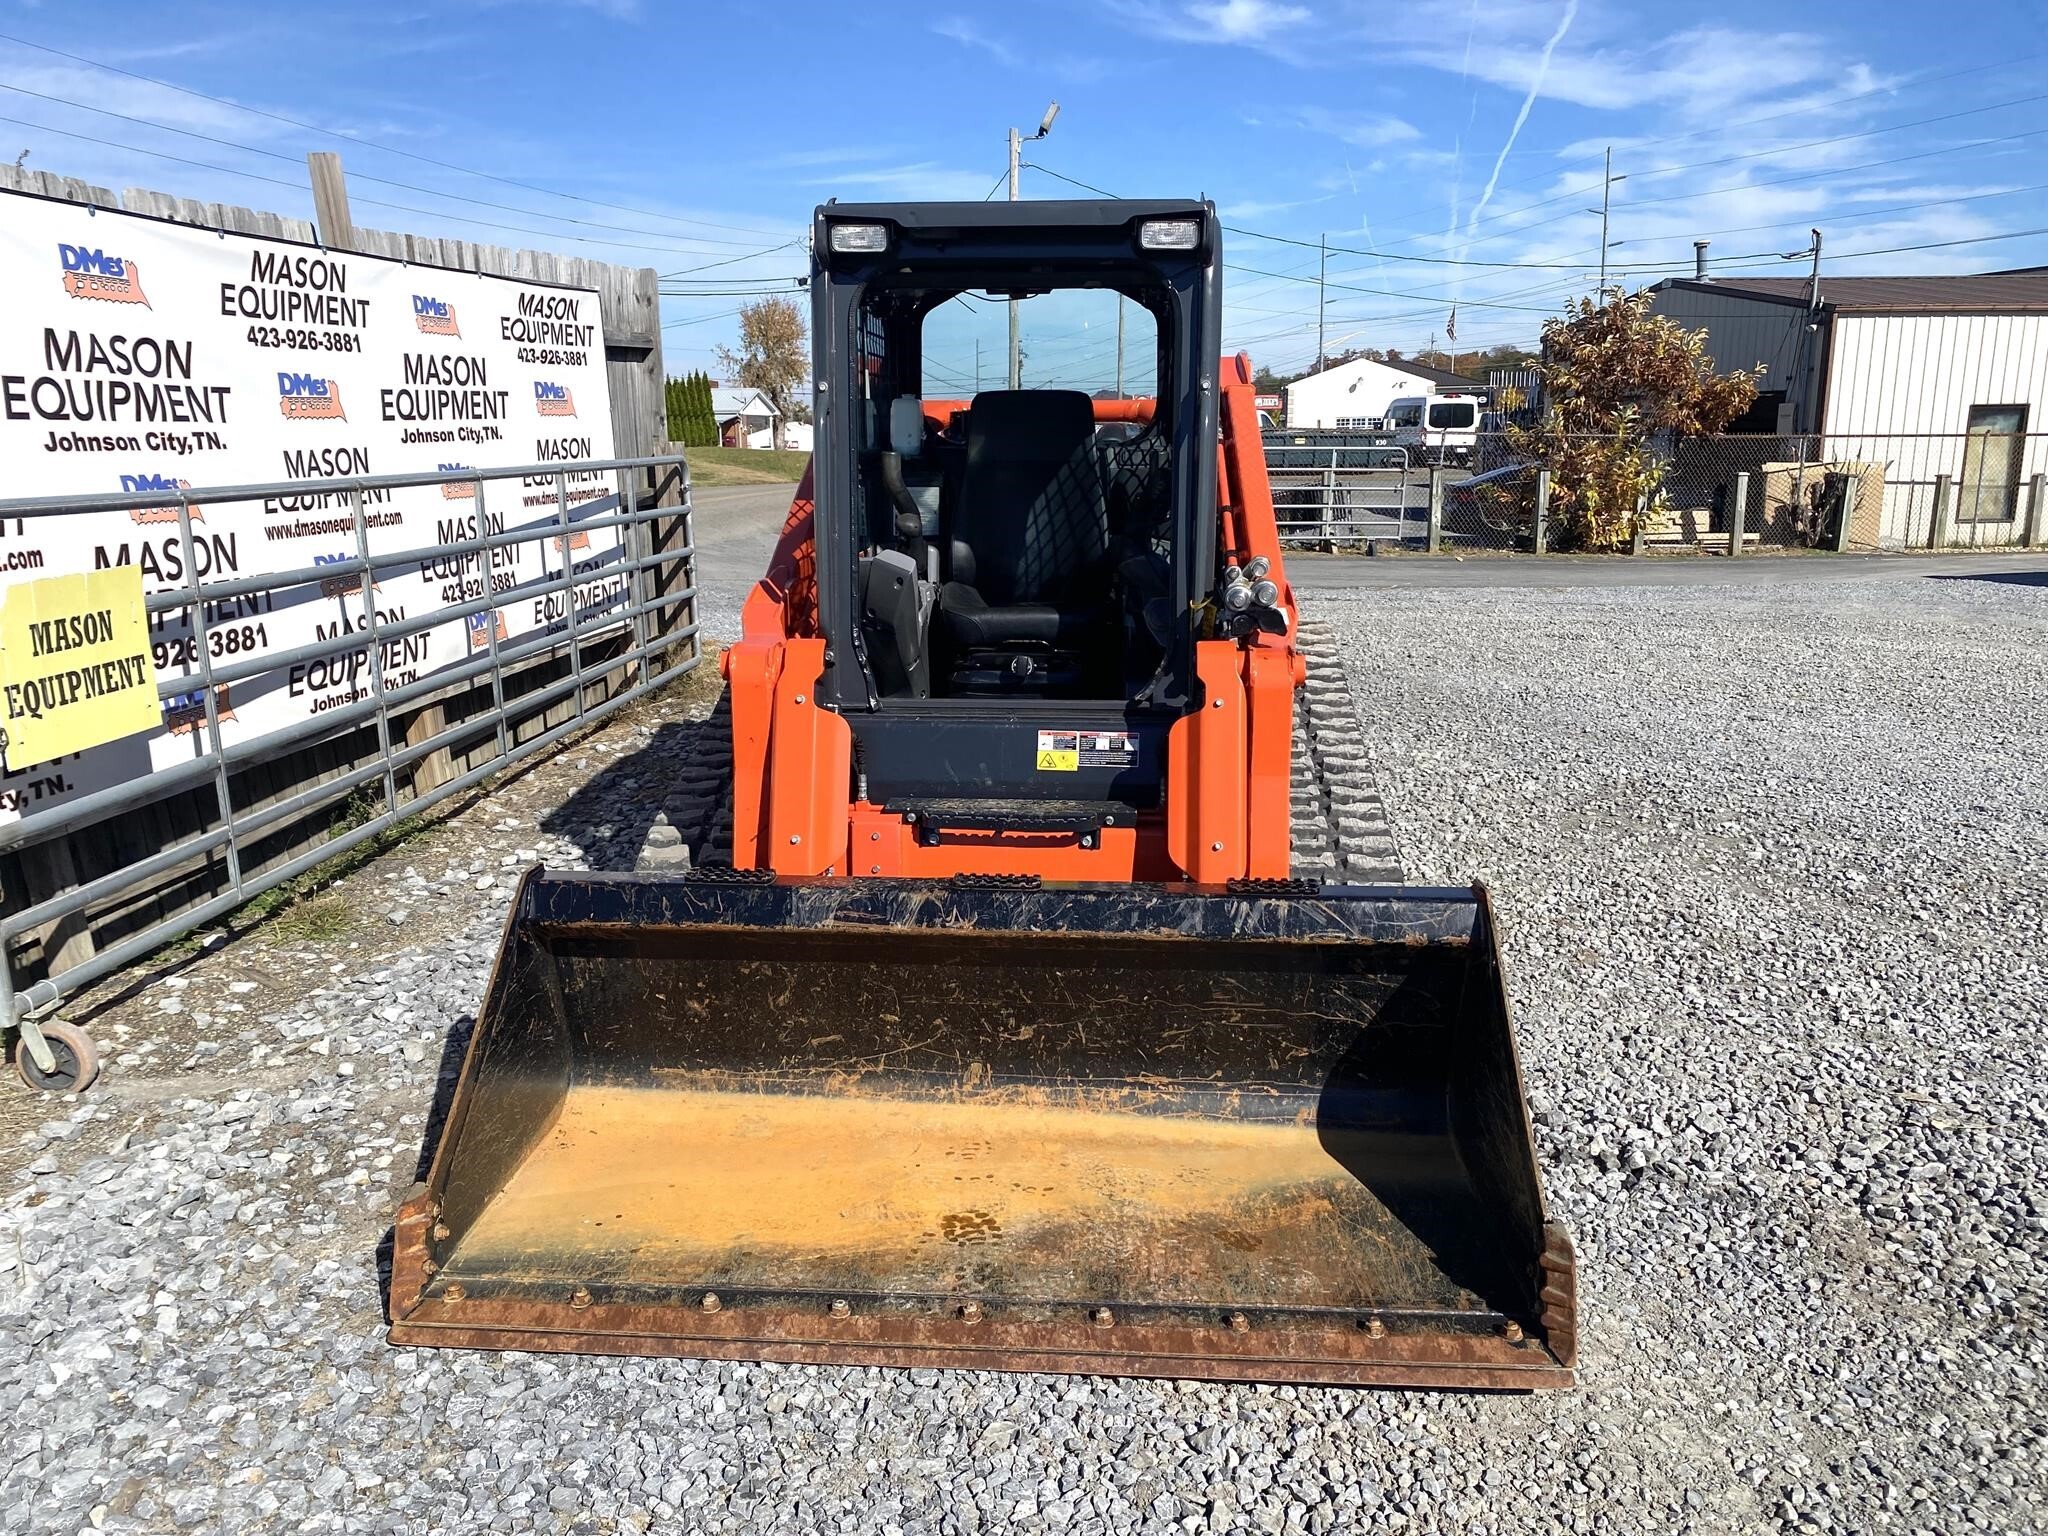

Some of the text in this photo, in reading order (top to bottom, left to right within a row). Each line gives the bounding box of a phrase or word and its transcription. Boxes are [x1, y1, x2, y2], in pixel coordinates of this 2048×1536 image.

[250, 250, 346, 293] MASON
[220, 282, 370, 329] EQUIPMENT
[518, 292, 580, 322] MASON
[247, 325, 362, 353] 423-926-3881
[500, 316, 595, 347] EQUIPMENT
[44, 327, 193, 380] MASON
[517, 347, 588, 366] 423-926-3881
[403, 352, 487, 387] MASON
[1, 375, 232, 424] EQUIPMENT
[380, 388, 509, 421] EQUIPMENT
[44, 431, 141, 452] Johnson
[401, 428, 455, 444] Johnson
[537, 437, 592, 461] MASON
[283, 447, 370, 478] MASON
[523, 487, 609, 507] www.dmasequipment.com
[264, 510, 403, 541] www.dmasonequient.com
[29, 609, 114, 657] MASON
[4, 654, 146, 720] EQUIPMENT
[310, 687, 368, 714] Johnson
